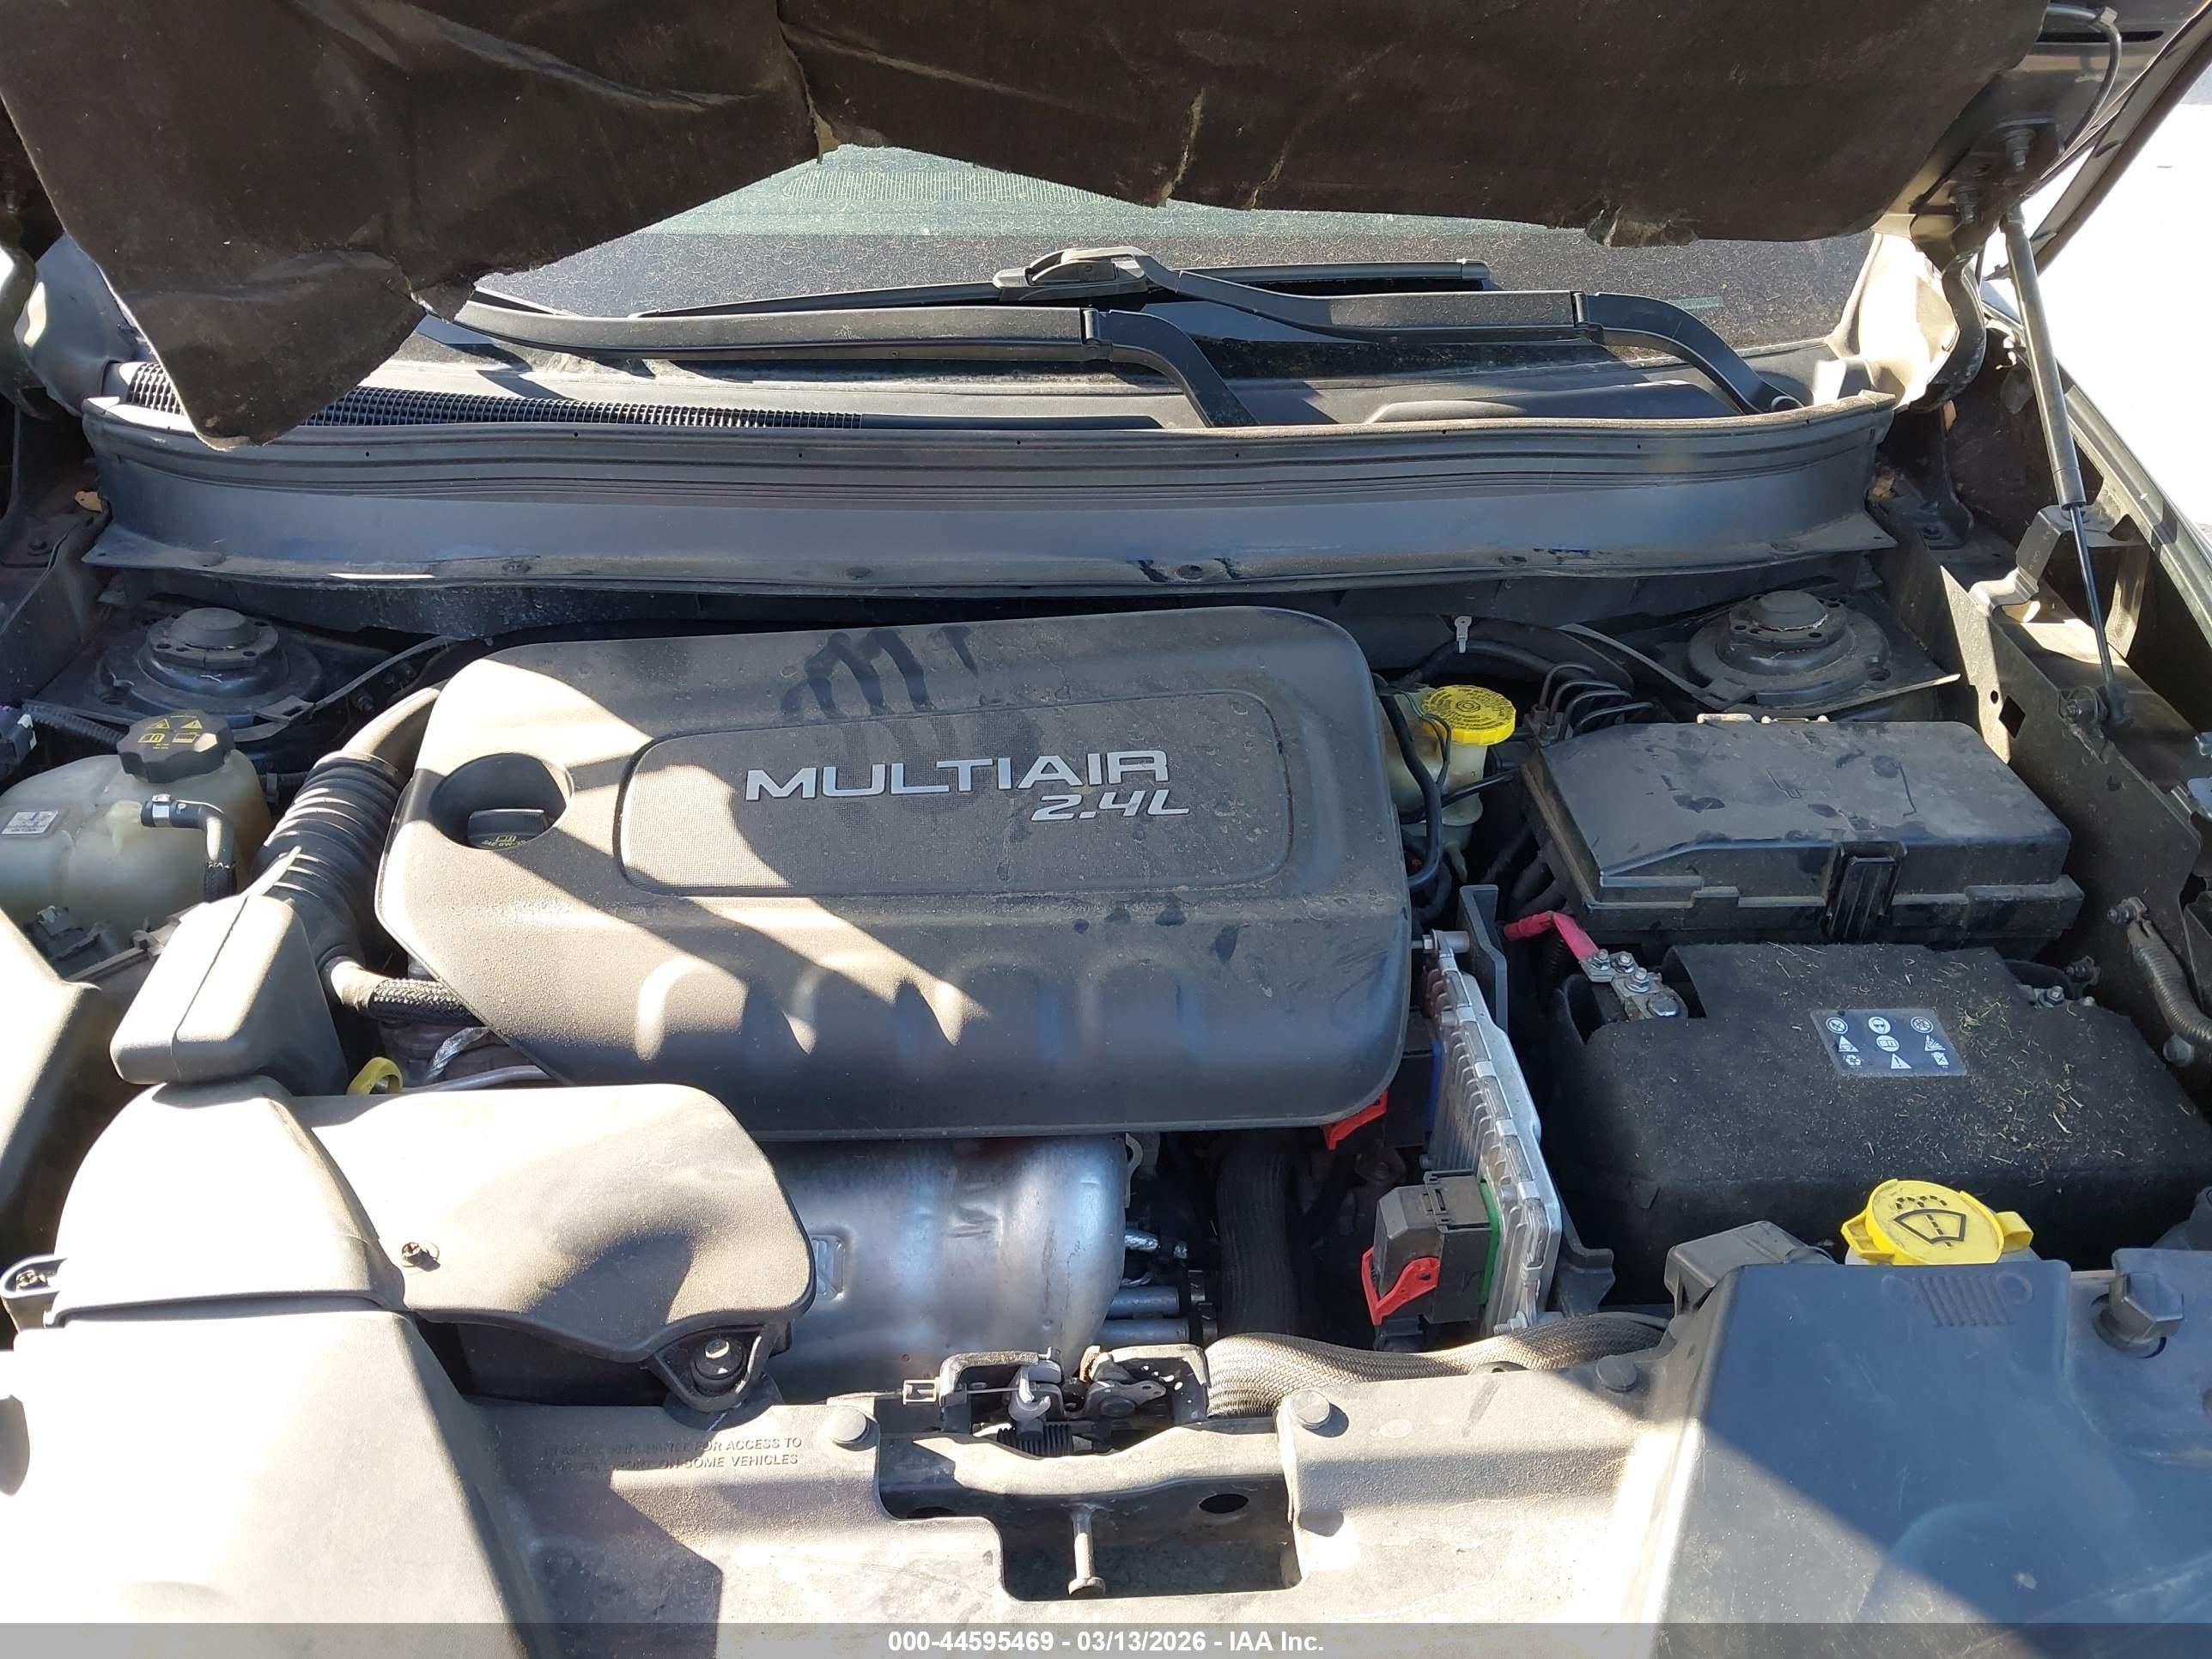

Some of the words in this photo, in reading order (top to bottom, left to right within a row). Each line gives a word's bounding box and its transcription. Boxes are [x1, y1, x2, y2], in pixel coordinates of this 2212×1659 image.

[744, 750, 1170, 801] MULTIAIR
[1030, 788, 1191, 822] 2.4L
[726, 1438, 780, 1451] ACCESS
[784, 1437, 803, 1449] TO
[684, 1456, 724, 1469] SOME
[731, 1453, 799, 1468] VEHICLES
